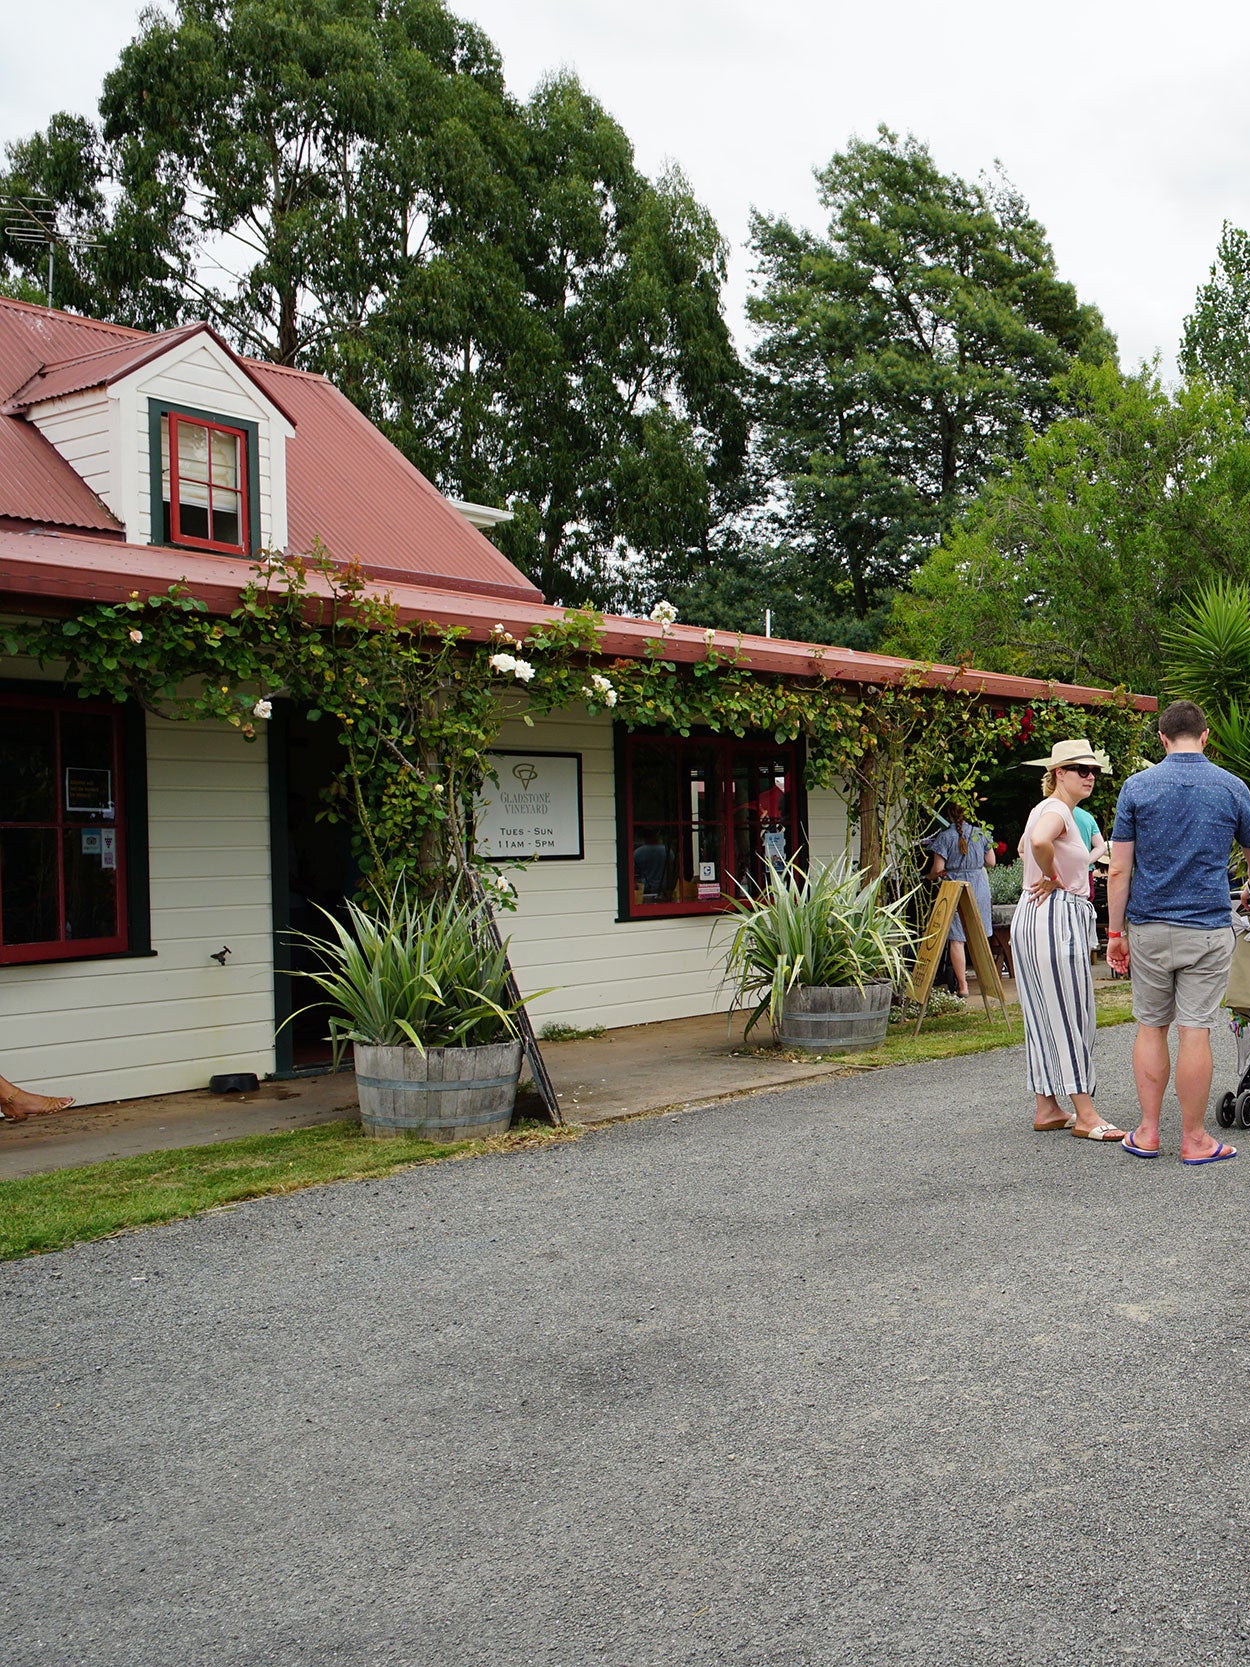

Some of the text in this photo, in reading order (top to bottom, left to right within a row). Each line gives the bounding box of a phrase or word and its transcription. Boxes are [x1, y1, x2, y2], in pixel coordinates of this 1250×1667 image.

[500, 792, 551, 803] GLADSTONE
[504, 804, 548, 814] VINEYARD
[500, 828, 524, 836] TUES
[534, 827, 553, 836] SUN
[535, 839, 555, 848] 5PM
